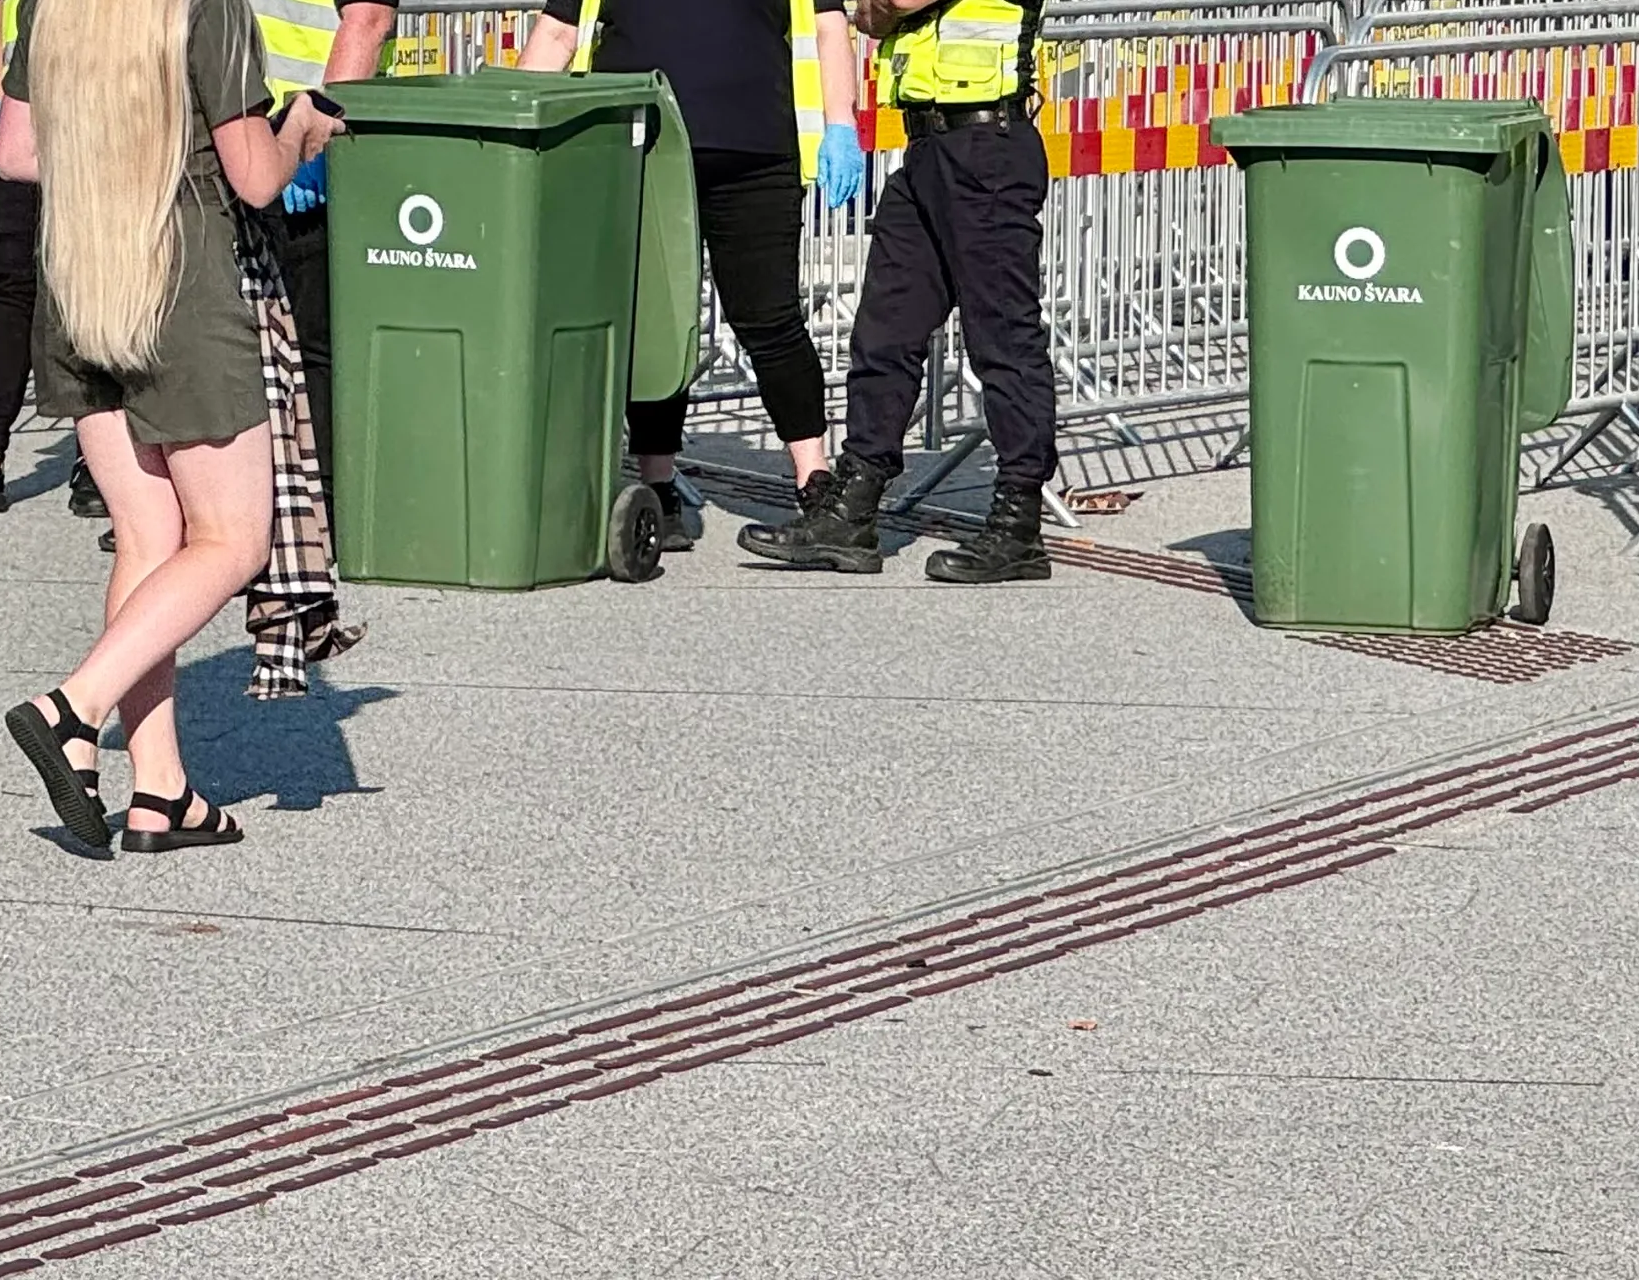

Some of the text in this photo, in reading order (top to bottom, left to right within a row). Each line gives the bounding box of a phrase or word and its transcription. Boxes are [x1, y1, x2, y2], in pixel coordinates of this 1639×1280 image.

[366, 247, 478, 270] KAUNO ŠVARA
[1297, 282, 1424, 303] KAUNO ŠVARA
